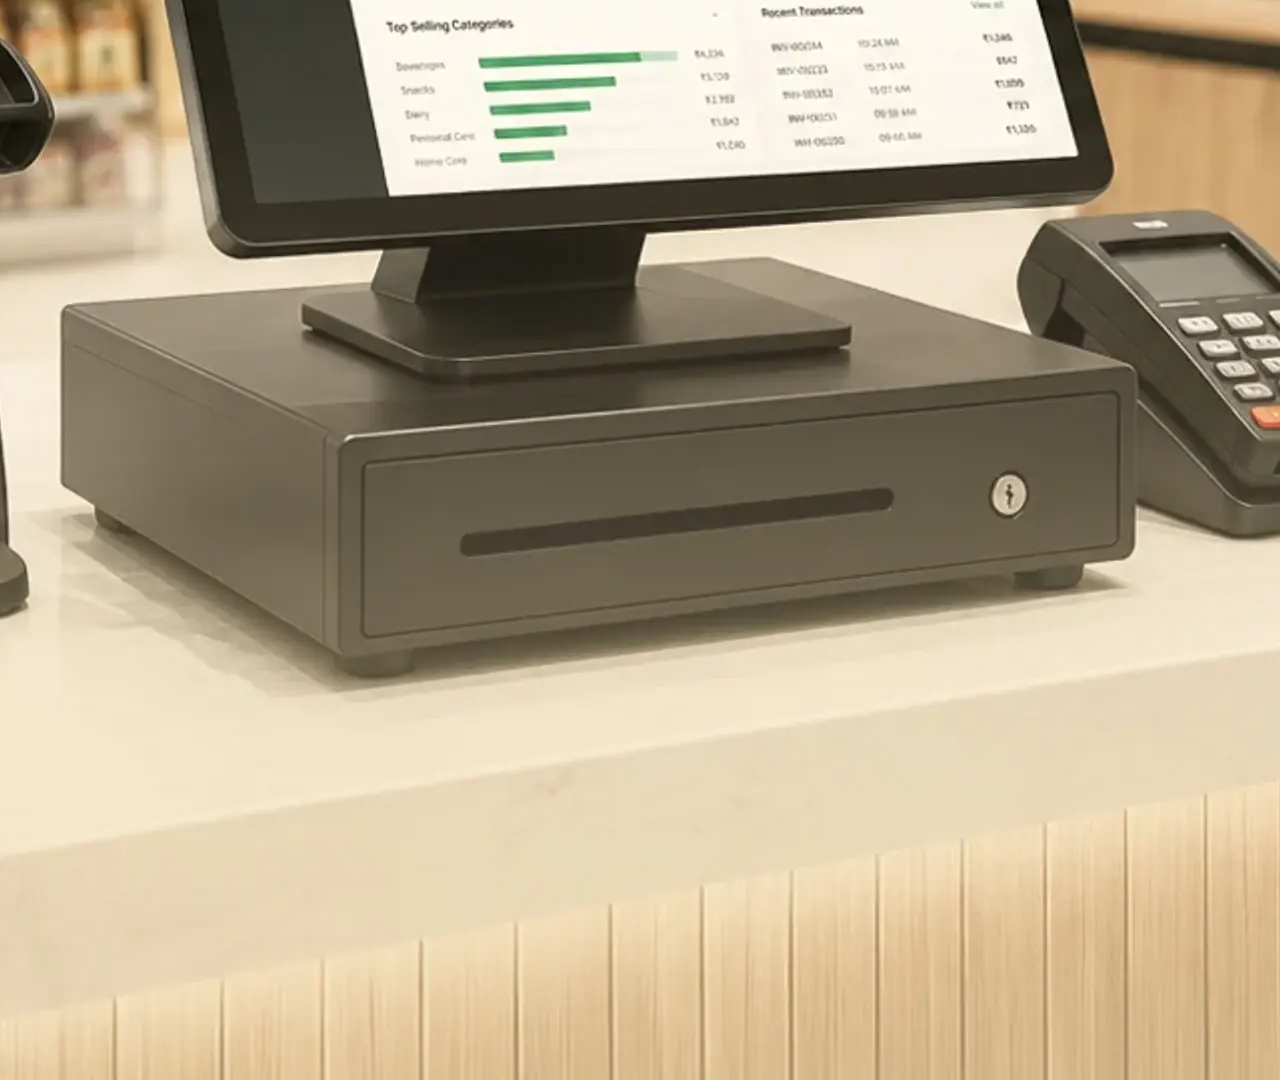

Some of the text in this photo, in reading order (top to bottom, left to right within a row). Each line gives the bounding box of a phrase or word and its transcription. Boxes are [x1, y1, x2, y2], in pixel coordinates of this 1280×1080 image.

[761, 6, 864, 18] Recent Transactions
[386, 19, 514, 34] Top Selling Categories
